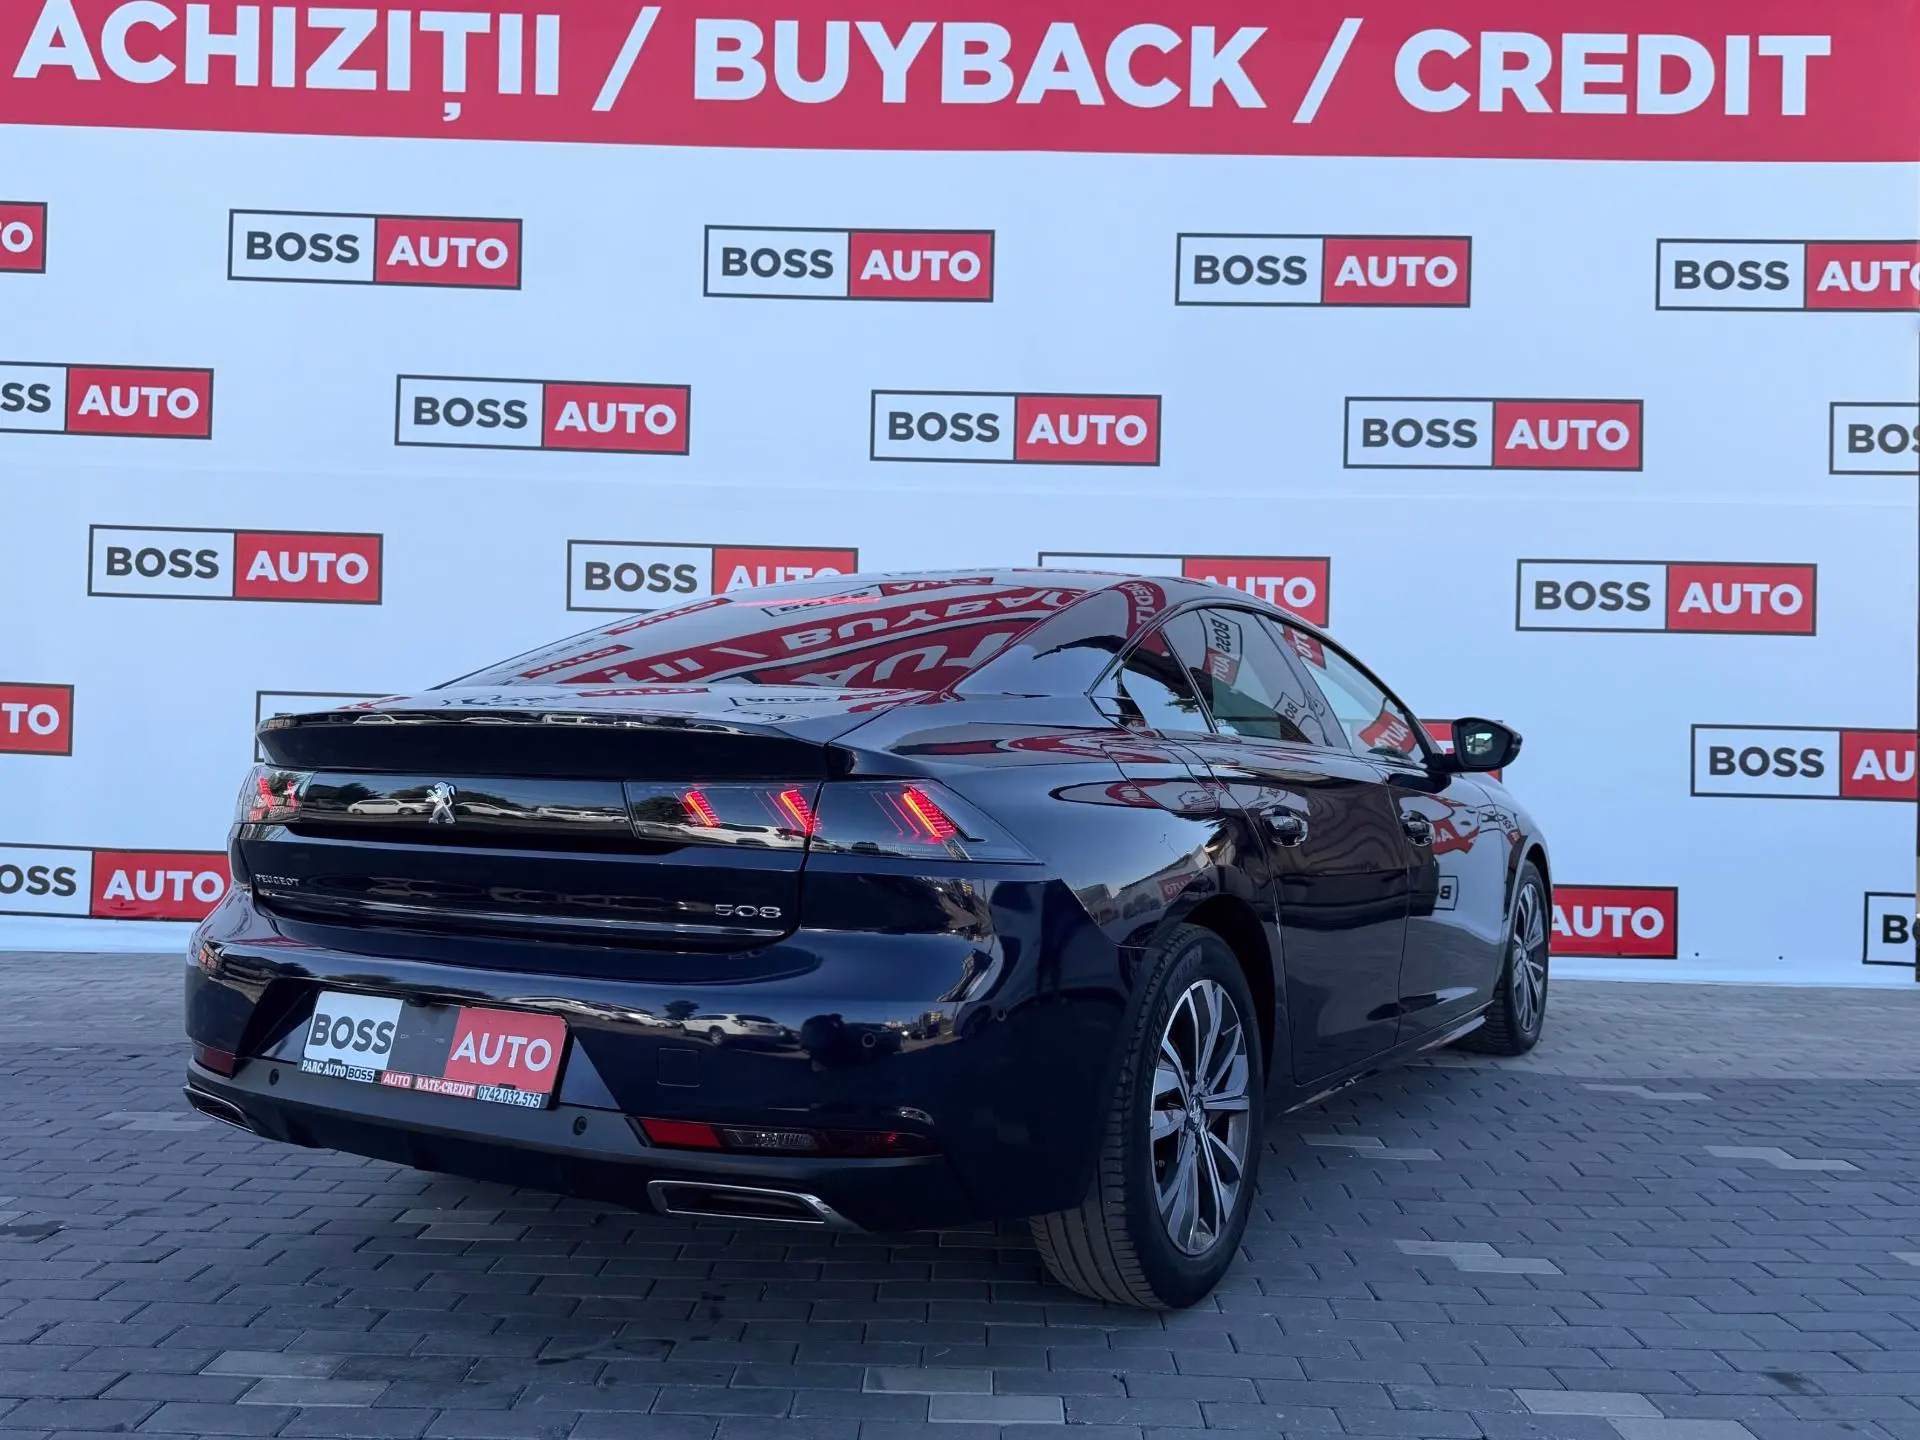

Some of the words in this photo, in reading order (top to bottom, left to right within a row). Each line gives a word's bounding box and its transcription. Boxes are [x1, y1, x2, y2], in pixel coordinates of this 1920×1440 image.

[13, 0, 559, 121] ACHIZIȚII
[694, 18, 1267, 109] BUYBACK
[1394, 29, 1831, 116] CREDIT
[247, 231, 359, 263] BOSS
[387, 236, 508, 268] AUTO
[722, 247, 833, 278] BOSS
[861, 250, 980, 281] AUTO
[1194, 255, 1307, 285] BOSS
[1335, 256, 1457, 287] AUTO
[1675, 260, 1789, 290] BOSS
[78, 385, 198, 418] AUTO
[414, 397, 527, 429] BOSS
[555, 402, 676, 434] AUTO
[889, 412, 999, 442] BOSS
[1027, 414, 1147, 445] AUTO
[1363, 418, 1477, 448] BOSS
[1505, 419, 1629, 450] AUTO
[1849, 424, 1919, 454] BO
[107, 547, 219, 579] BOSS
[247, 551, 368, 584] AUTO
[585, 562, 697, 593] BOSS
[725, 565, 841, 592] AUT
[1204, 576, 1316, 607] UTO
[1535, 581, 1650, 611] BOSS
[1679, 583, 1802, 614] AUTO
[2, 703, 59, 734] TO
[1710, 746, 1824, 778] BOSS
[1853, 750, 1915, 781] AU
[0, 864, 76, 896] OSS
[104, 870, 224, 902] AUTO
[255, 873, 299, 887] PEUGEOT
[714, 904, 782, 919] 508
[1552, 905, 1663, 938] AUTO
[1882, 914, 1917, 945] B
[309, 1013, 396, 1054] BOSS
[451, 1031, 552, 1072] AUTO
[301, 1059, 324, 1074] PARC
[323, 1063, 347, 1077] AUTO
[347, 1068, 374, 1081] BOSS
[383, 1073, 410, 1087] AUTO
[479, 1086, 540, 1107] 0742.032.575
